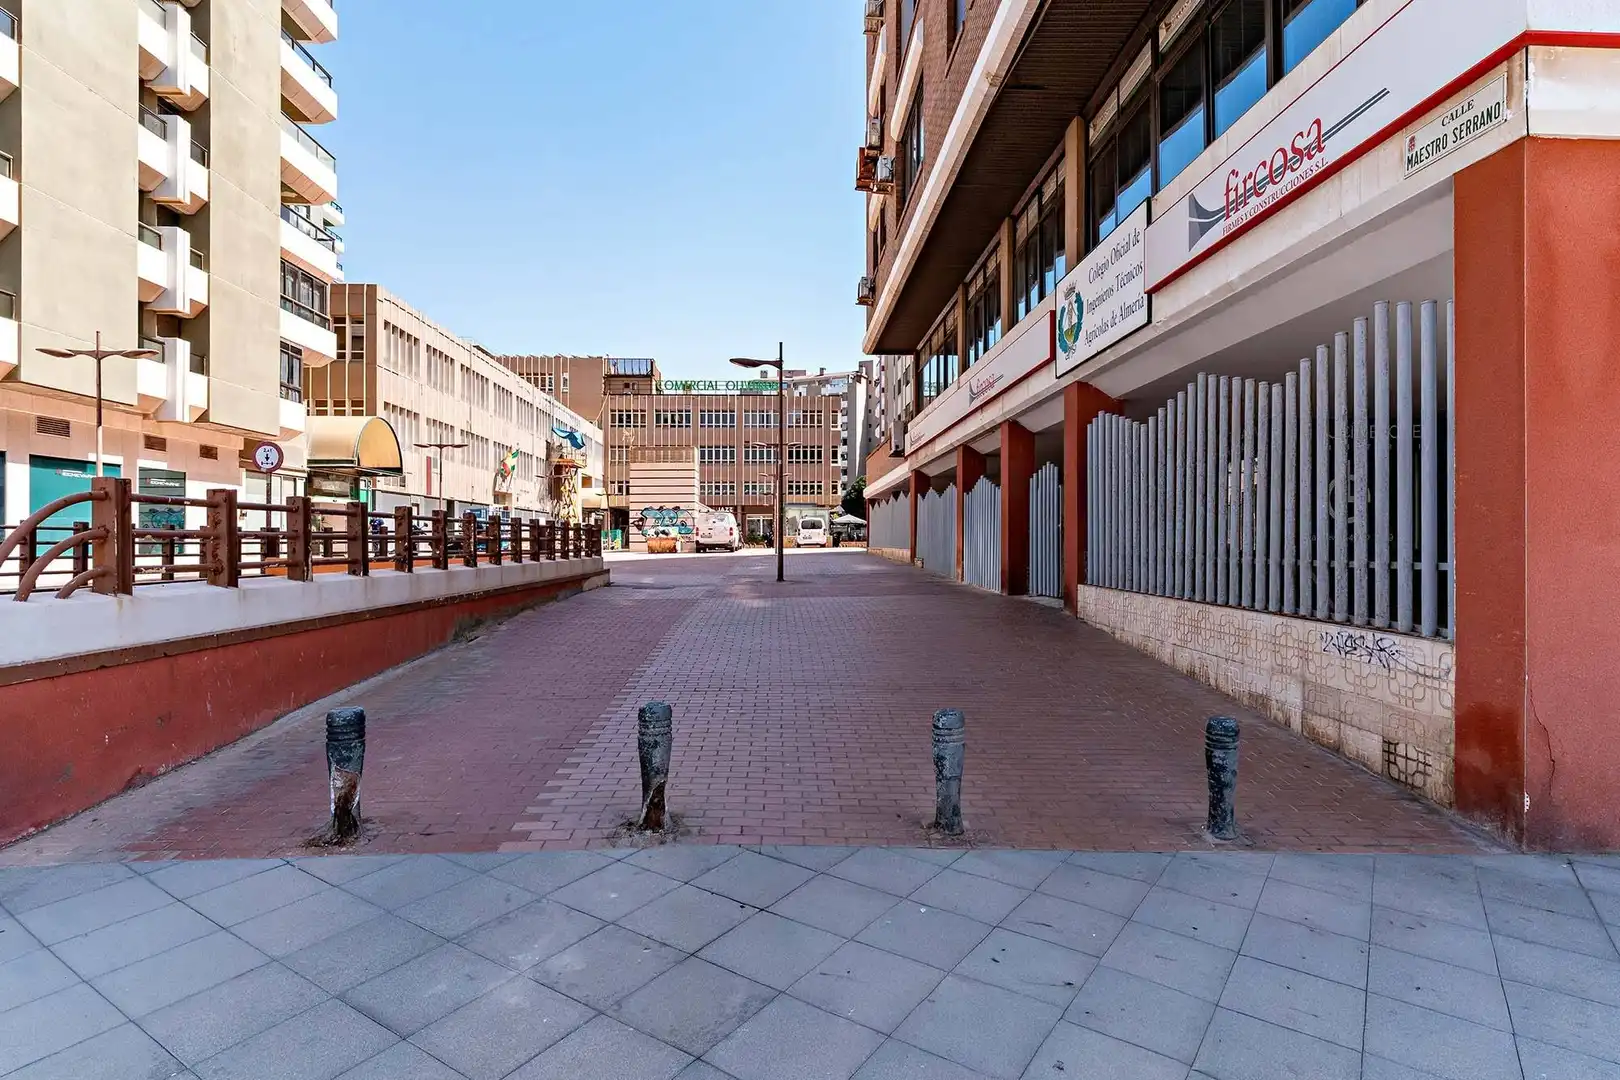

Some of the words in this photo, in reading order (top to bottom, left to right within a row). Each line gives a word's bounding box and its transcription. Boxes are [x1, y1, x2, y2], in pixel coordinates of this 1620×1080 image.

[1406, 133, 1448, 171] MAESTRO
[1452, 101, 1501, 143] SERRANO
[1441, 99, 1475, 126] CALLE
[1224, 118, 1326, 221] fircosa
[1222, 215, 1244, 236] FIRMES
[1249, 168, 1314, 217] CONSTRUCCIONES
[1088, 255, 1110, 284] Colegio
[1111, 236, 1131, 266] Oficial
[1132, 228, 1141, 247] de
[1086, 283, 1114, 316] Ingenieros
[1115, 259, 1144, 293] Técnicos
[1084, 319, 1109, 347] Agrícolas
[1110, 313, 1117, 329] de
[1119, 292, 1145, 322] Almería
[656, 380, 720, 391] COMERCIAL
